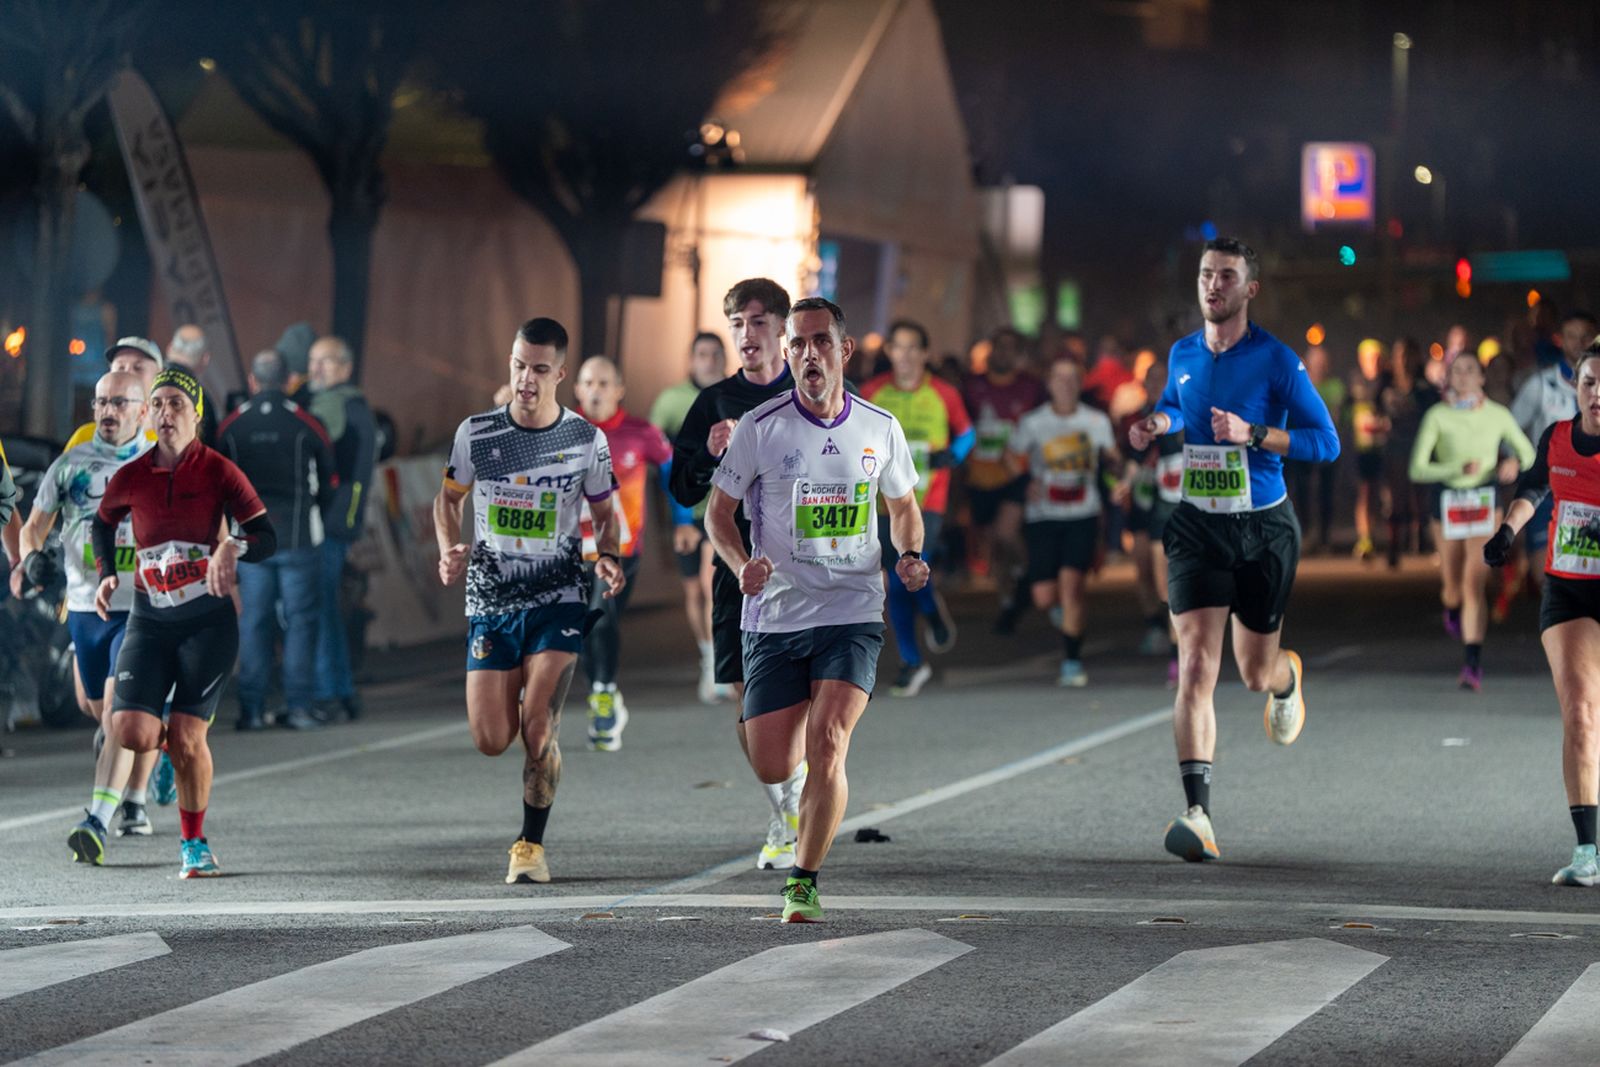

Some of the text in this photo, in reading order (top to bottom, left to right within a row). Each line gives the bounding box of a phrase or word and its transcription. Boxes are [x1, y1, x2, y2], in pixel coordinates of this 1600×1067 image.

[1189, 470, 1240, 490] 13990
[502, 490, 534, 500] NOCHE DE
[811, 486, 847, 495] NOCHE DE
[493, 498, 534, 509] SAN ANTÓN
[801, 494, 848, 506] SAN ANTÓN
[496, 507, 547, 531] 6884
[812, 505, 859, 530] 3417
